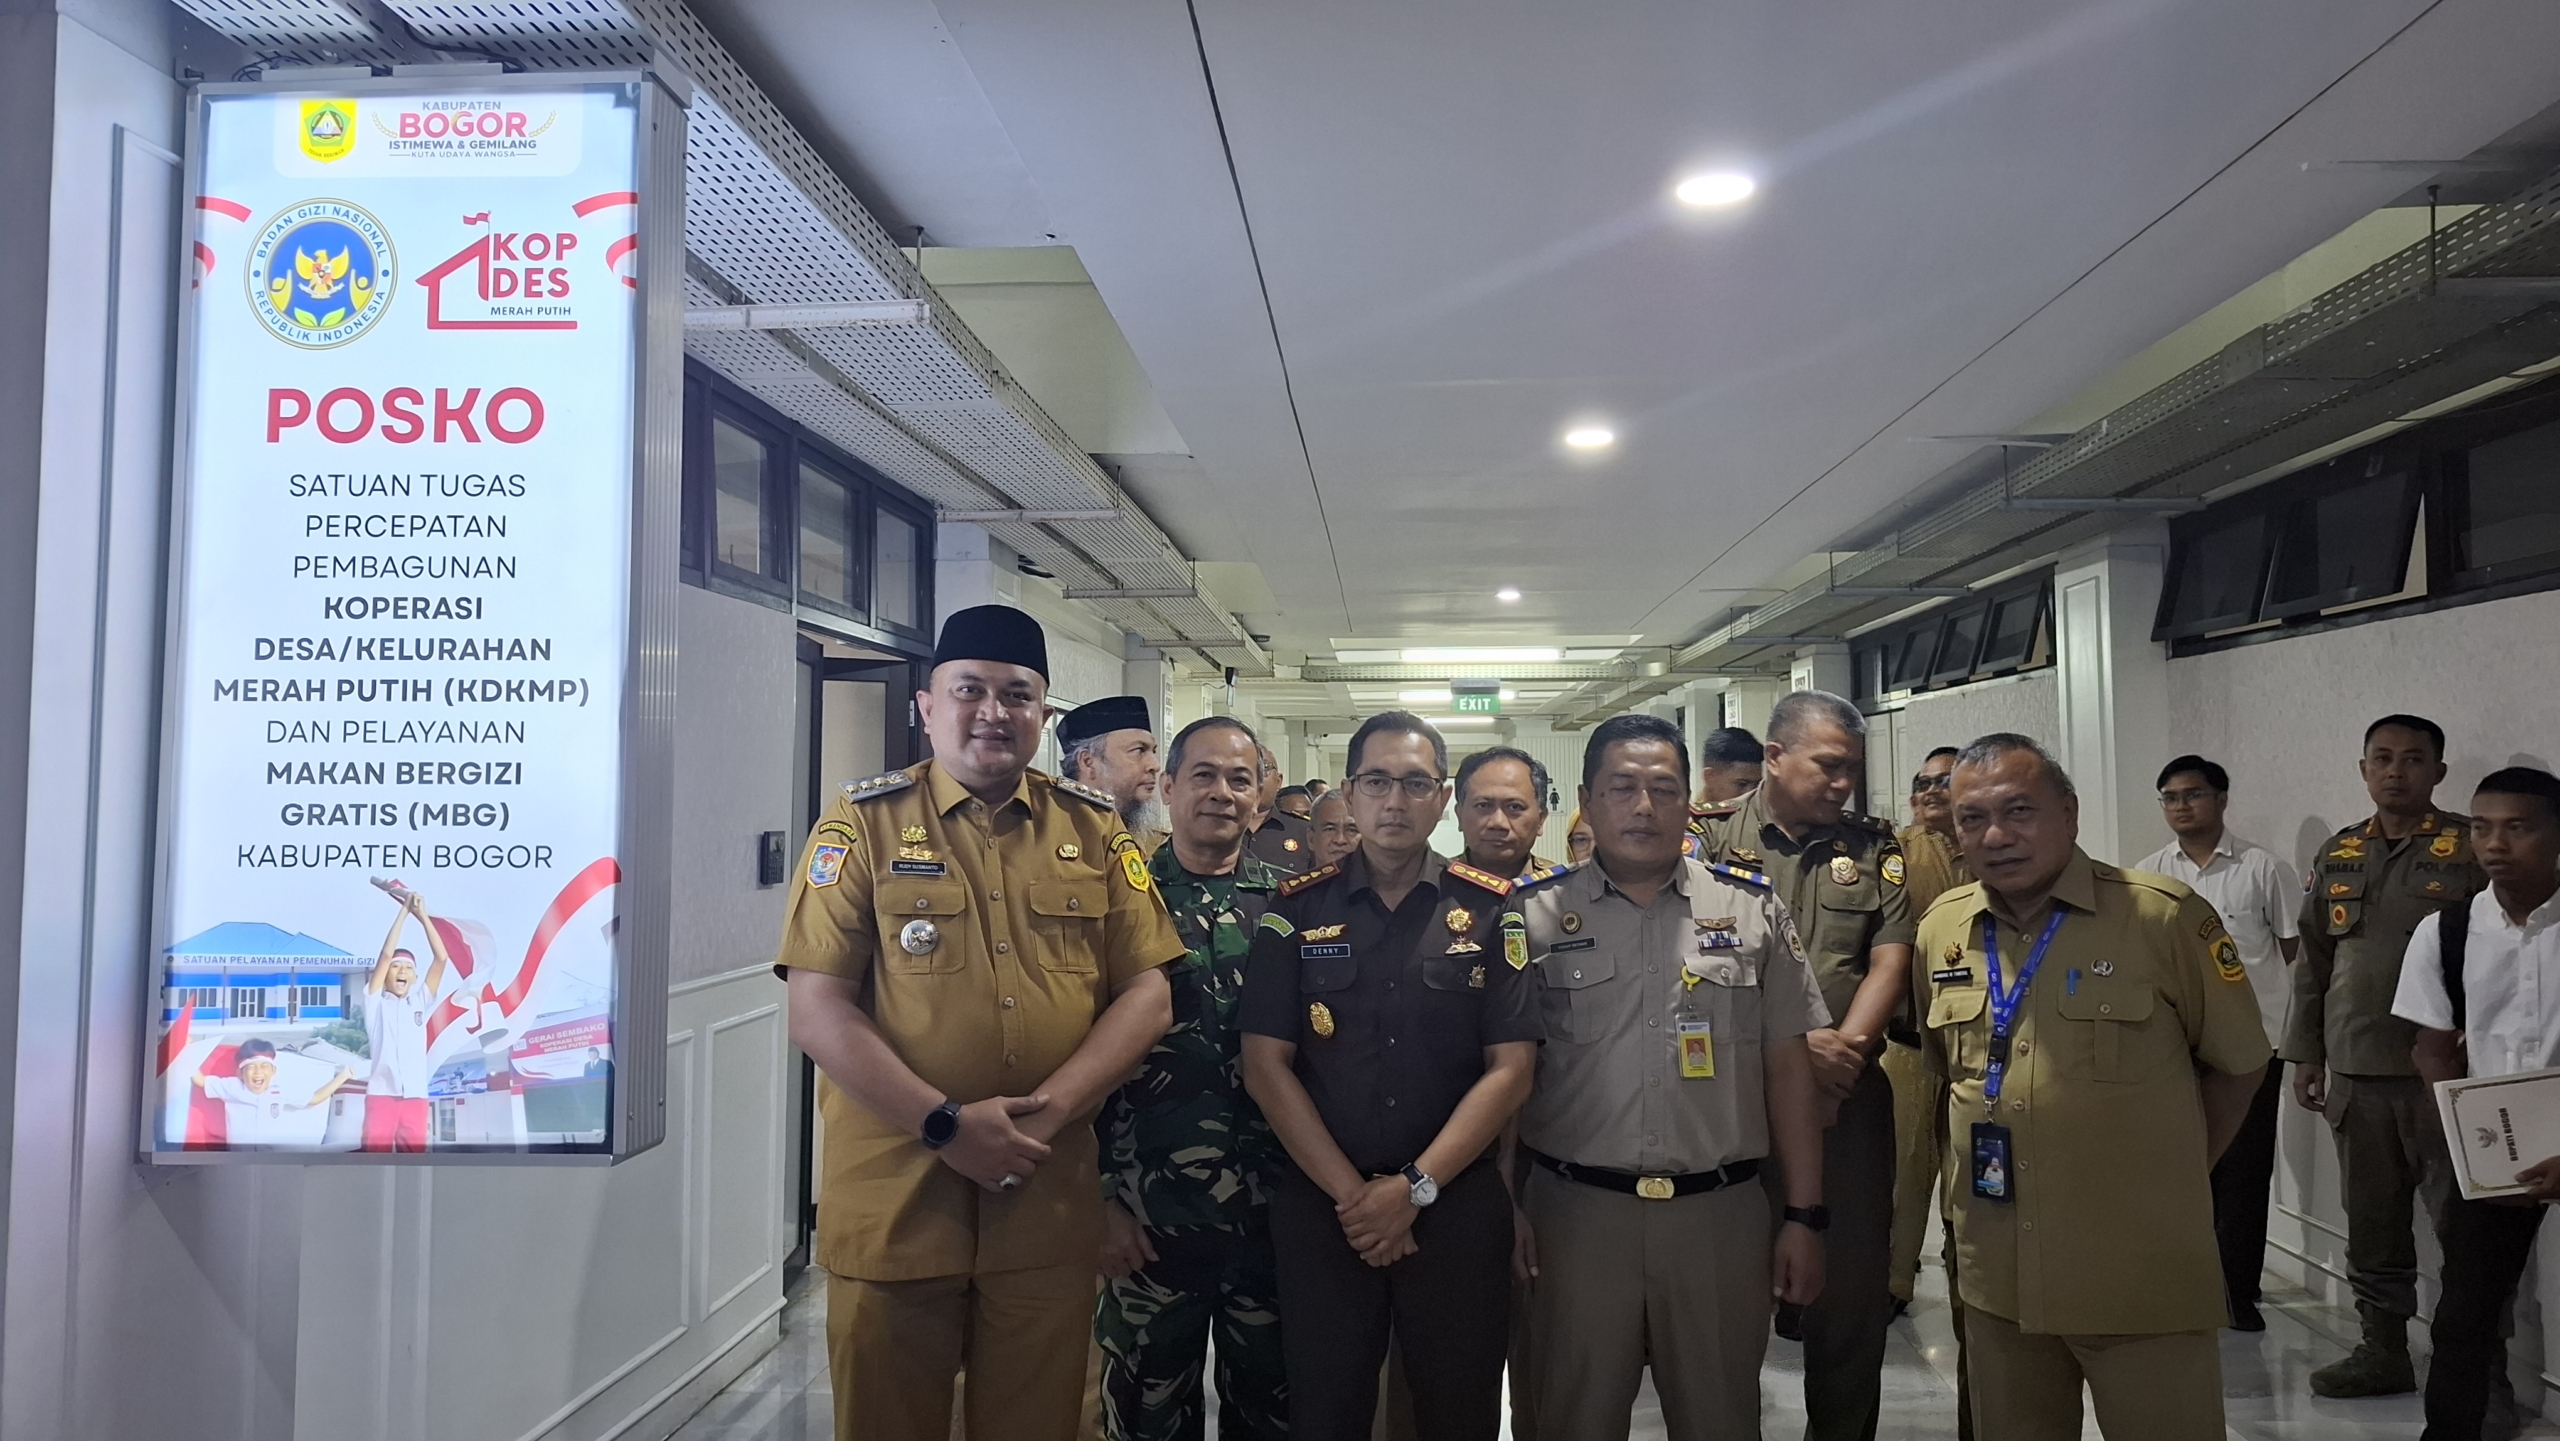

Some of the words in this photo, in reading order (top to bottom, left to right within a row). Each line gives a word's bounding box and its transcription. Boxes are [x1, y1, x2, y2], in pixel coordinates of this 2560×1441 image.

[422, 101, 502, 110] KABUPATEN
[399, 111, 527, 138] BOGOR
[389, 140, 454, 150] ISTIMEWA
[458, 141, 465, 149] &
[469, 139, 537, 149] GEMILANG
[474, 150, 516, 158] WANGSA
[257, 216, 293, 258] BADAN
[298, 205, 326, 218] GIZI
[332, 206, 387, 258] NASIONAL
[493, 232, 578, 262] KOP
[493, 268, 570, 299] DES
[255, 290, 311, 342] REPUBLIK
[318, 291, 386, 342] INDONESIA
[491, 307, 532, 315] MERAH
[538, 307, 570, 315] PUTIH
[267, 387, 544, 444] POSKO
[290, 474, 410, 497] SATUAN
[420, 474, 525, 497] TUGAS
[307, 515, 505, 537] PERCEPATAN
[294, 556, 515, 578] PEMBAGUNAN
[325, 597, 482, 619] KOPERASI
[255, 636, 550, 662] DESA/KELURAHAN
[214, 679, 325, 701] MERAH
[337, 679, 431, 702] PUTIH
[445, 678, 588, 706] (KDKMP)
[1459, 698, 1491, 711] EXIT
[268, 721, 330, 743] DAN
[343, 721, 524, 743] PELAYANAN
[267, 762, 384, 784] MAKAN
[397, 762, 521, 785] BERGIZI
[281, 803, 397, 826] GRATIS
[409, 802, 509, 831] (MBG)
[239, 845, 420, 867] KABUPATEN
[434, 845, 552, 868] BOGOR
[183, 955, 226, 964] SATUAN
[230, 956, 290, 965] PELAYANAN
[294, 956, 354, 966] PEMENUHAN
[357, 957, 376, 966] GIZI
[528, 1034, 555, 1044] GERAI
[556, 1023, 606, 1039] SEMBAKO
[540, 1037, 573, 1048] KOPERASI
[573, 1034, 594, 1042] DESA
[2499, 1107, 2513, 1134] BOGOR
[2505, 1134, 2519, 1162] BUPATI
